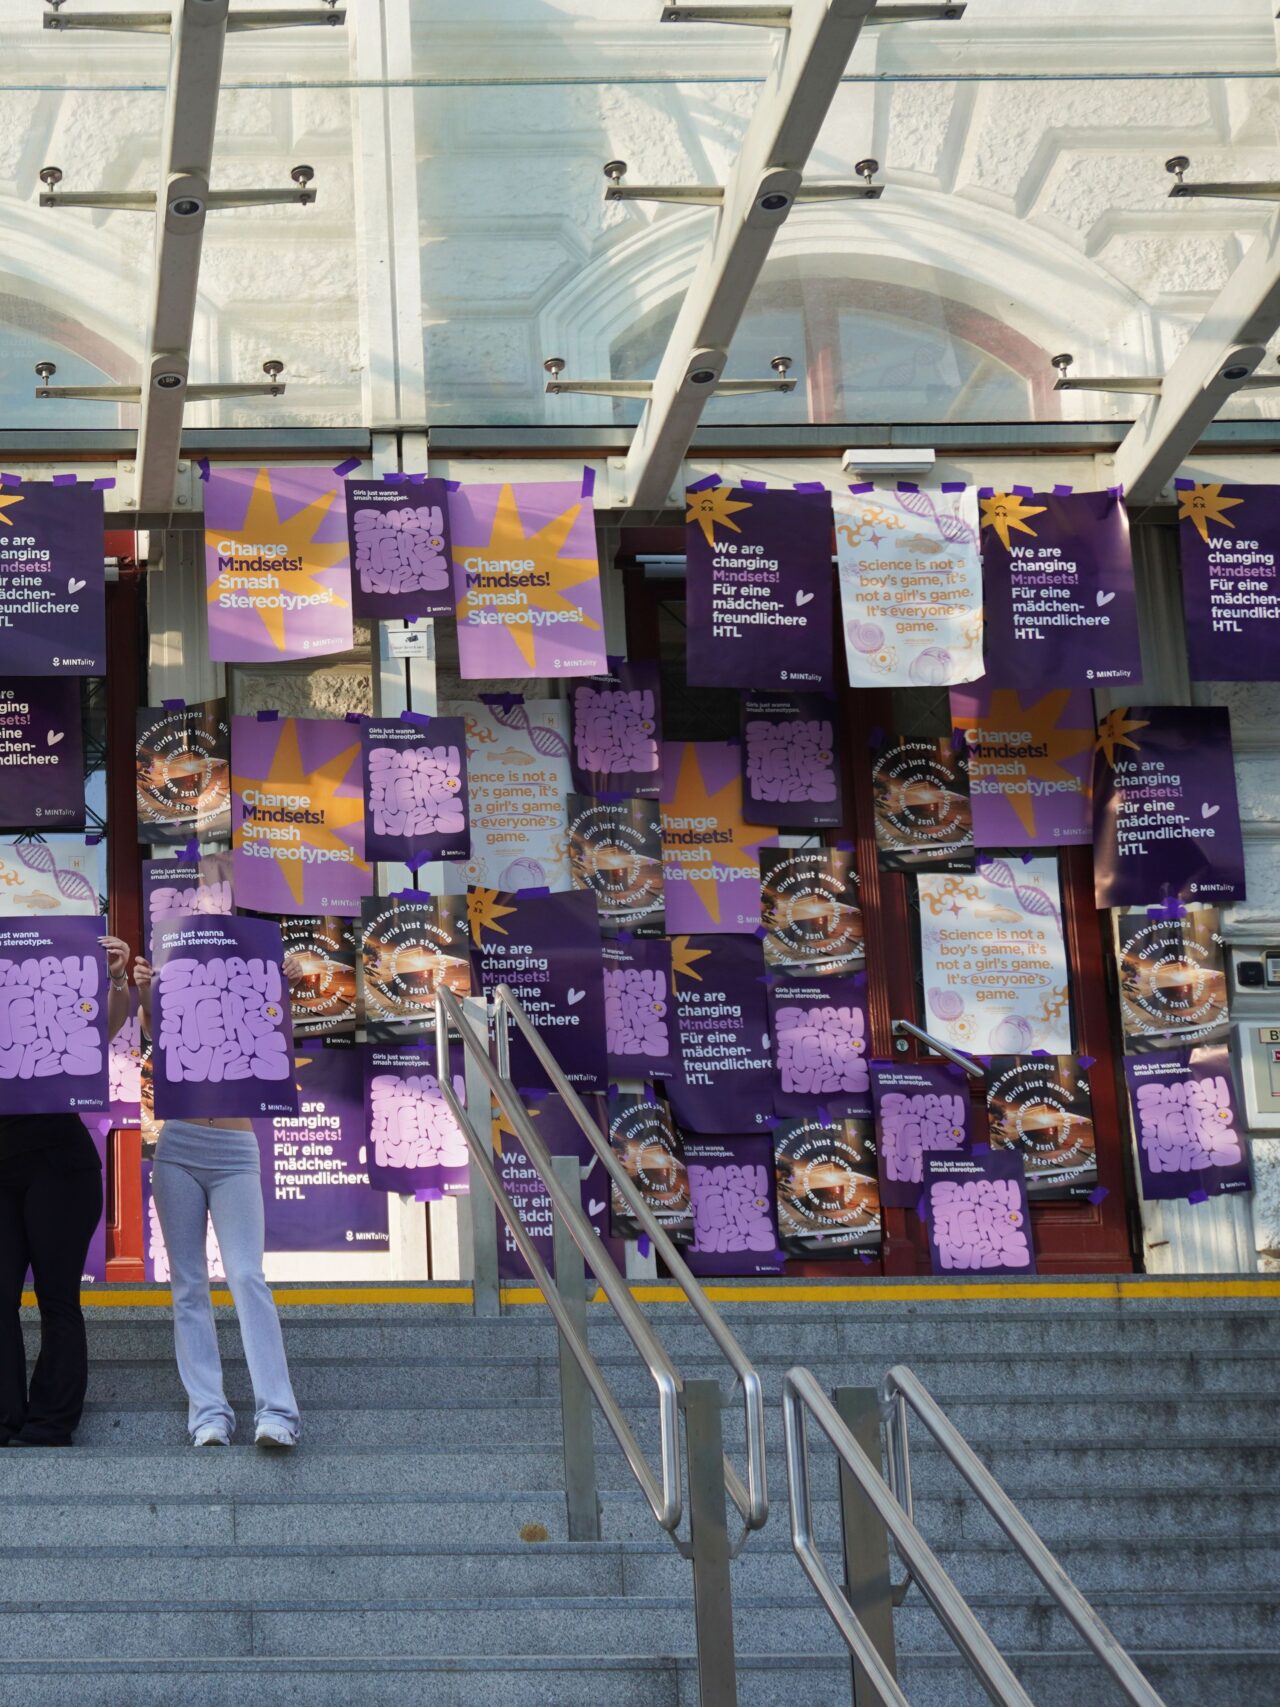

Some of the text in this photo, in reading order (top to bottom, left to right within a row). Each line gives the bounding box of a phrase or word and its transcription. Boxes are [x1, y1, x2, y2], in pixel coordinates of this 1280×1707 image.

[217, 541, 288, 558] Change
[713, 543, 764, 554] We are
[218, 557, 302, 572] M:ndsets!
[712, 556, 778, 571] changing
[219, 574, 279, 589] Smash
[713, 570, 780, 582] M:ndsets!
[713, 584, 770, 596] Für eine
[219, 588, 334, 610] Stereotypes!
[713, 598, 784, 610] mädchen-
[712, 611, 807, 626] freundlichere
[713, 626, 742, 637] HTL
[790, 673, 822, 682] MINTality
[965, 729, 1032, 747] Change
[970, 743, 1048, 758] M:ndsets!
[968, 759, 1027, 777] Smash
[1114, 762, 1165, 772] We are
[969, 777, 1082, 796] Stereotypes!
[1113, 773, 1180, 788] changing
[1117, 786, 1183, 799] M:ndsets!
[1117, 800, 1175, 813] Für eine
[1116, 813, 1190, 828] mädchen-
[1117, 826, 1215, 842] freundlichere
[1118, 843, 1148, 856] HTL
[1200, 884, 1234, 892] MINTality
[162, 933, 178, 941] Girls
[180, 931, 195, 939] just
[939, 928, 1046, 940] Science is not a
[162, 938, 238, 948] smash stereotypes.
[940, 943, 1047, 957] boy's game, it's
[936, 958, 1053, 971] not a girl's game.
[948, 974, 1045, 986] It's everyone's
[976, 991, 1019, 1002] game.
[302, 1102, 325, 1112] are
[274, 1129, 342, 1141] M:ndsets!
[274, 1142, 333, 1156] Für eine
[274, 1157, 347, 1170] mädchen-
[274, 1171, 370, 1185] freundlichere
[276, 1186, 305, 1199] HTL
[356, 1232, 389, 1241] MINTality
